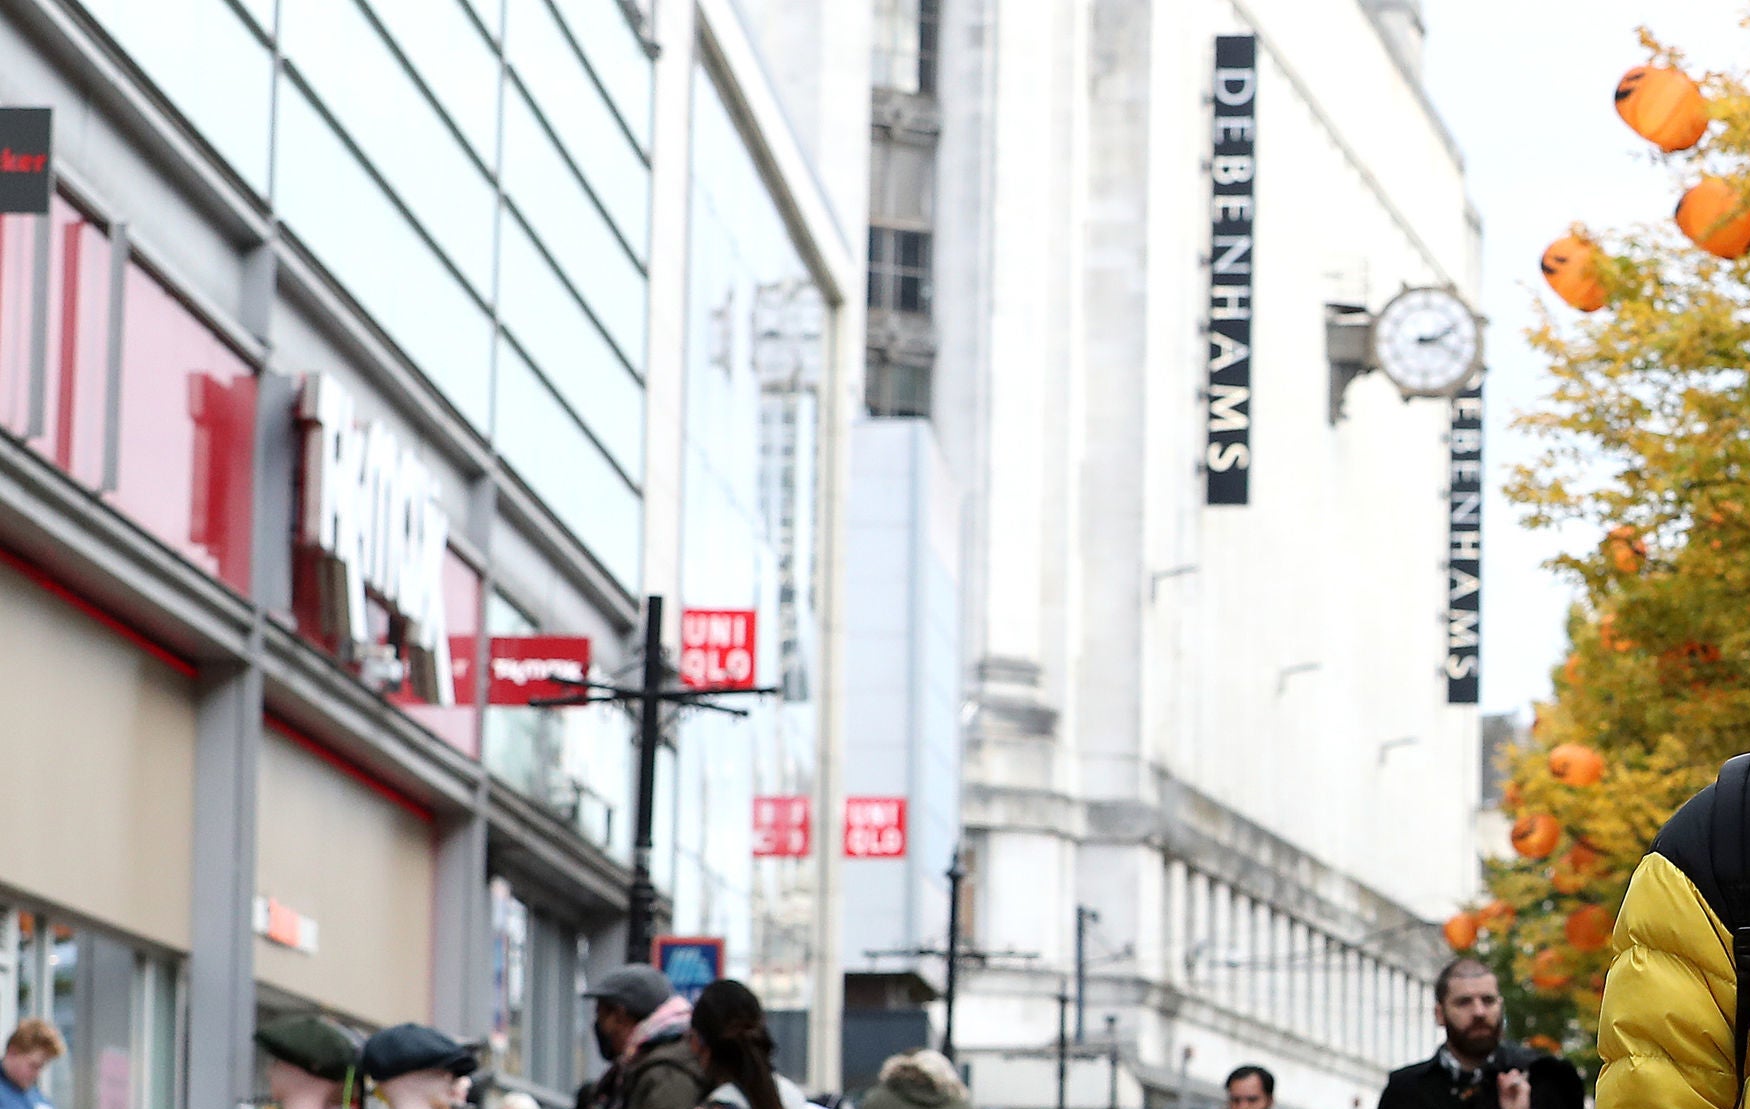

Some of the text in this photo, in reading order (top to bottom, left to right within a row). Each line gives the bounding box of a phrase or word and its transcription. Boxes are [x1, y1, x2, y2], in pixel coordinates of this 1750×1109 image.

[0, 147, 48, 173] ker
[1207, 68, 1256, 473] DEBENHAMS
[682, 614, 747, 647] UNI
[681, 648, 752, 686] QLO
